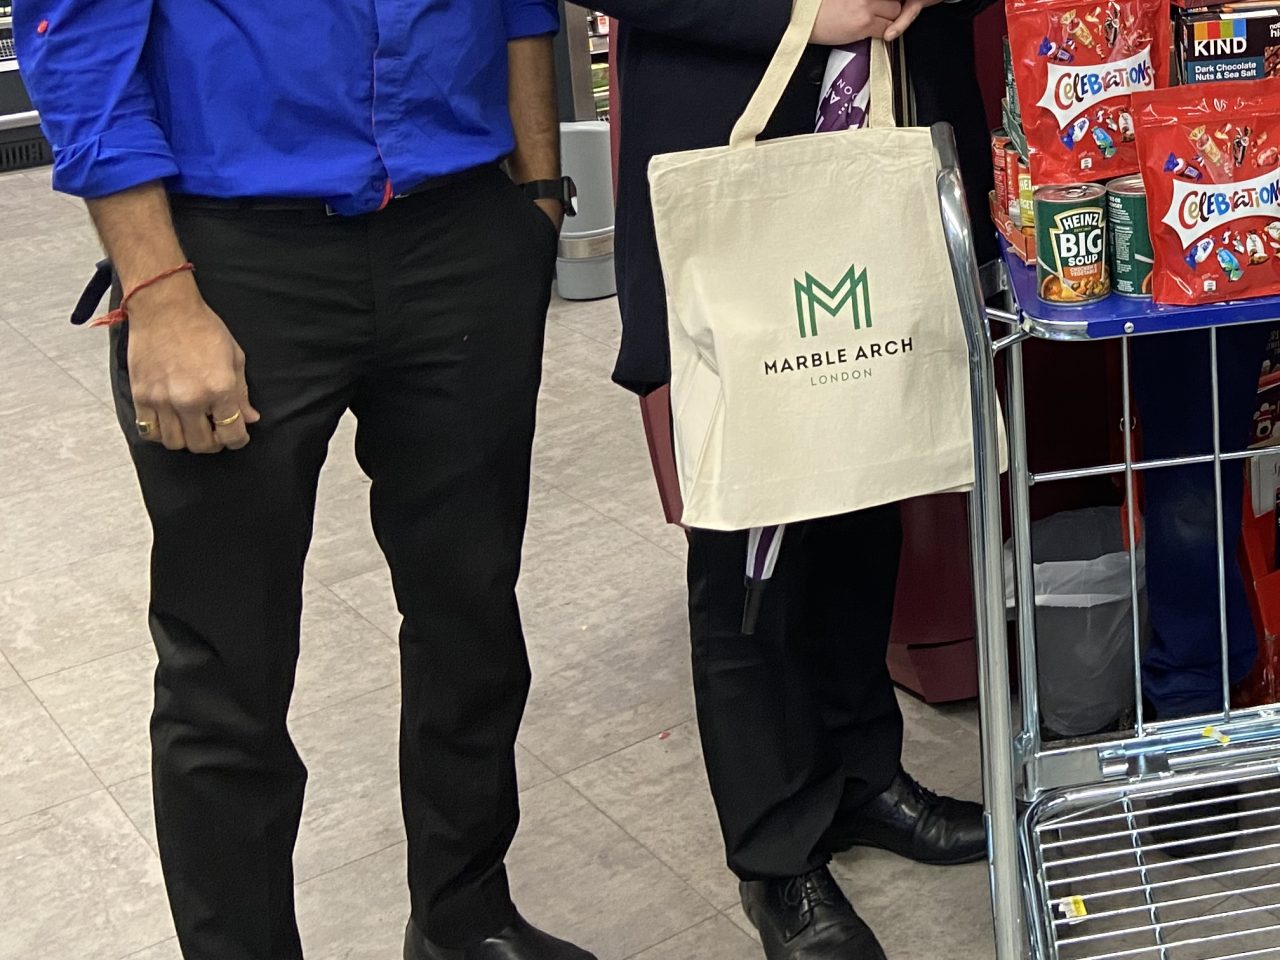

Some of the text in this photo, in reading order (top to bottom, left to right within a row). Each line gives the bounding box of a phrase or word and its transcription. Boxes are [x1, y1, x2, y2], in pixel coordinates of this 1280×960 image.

[1194, 38, 1247, 57] KIND
[1195, 62, 1256, 73] Dark Chocolate
[1195, 72, 1215, 81] Nuts
[1223, 70, 1239, 78] Sea
[1240, 69, 1256, 77] Salt
[1019, 179, 1031, 191] HEI
[1062, 213, 1099, 230] HEINZ
[1060, 228, 1103, 258] BIG
[1068, 253, 1098, 267] SOUP
[764, 337, 913, 375] MARBLE ARCH
[810, 368, 873, 386] LONDON
